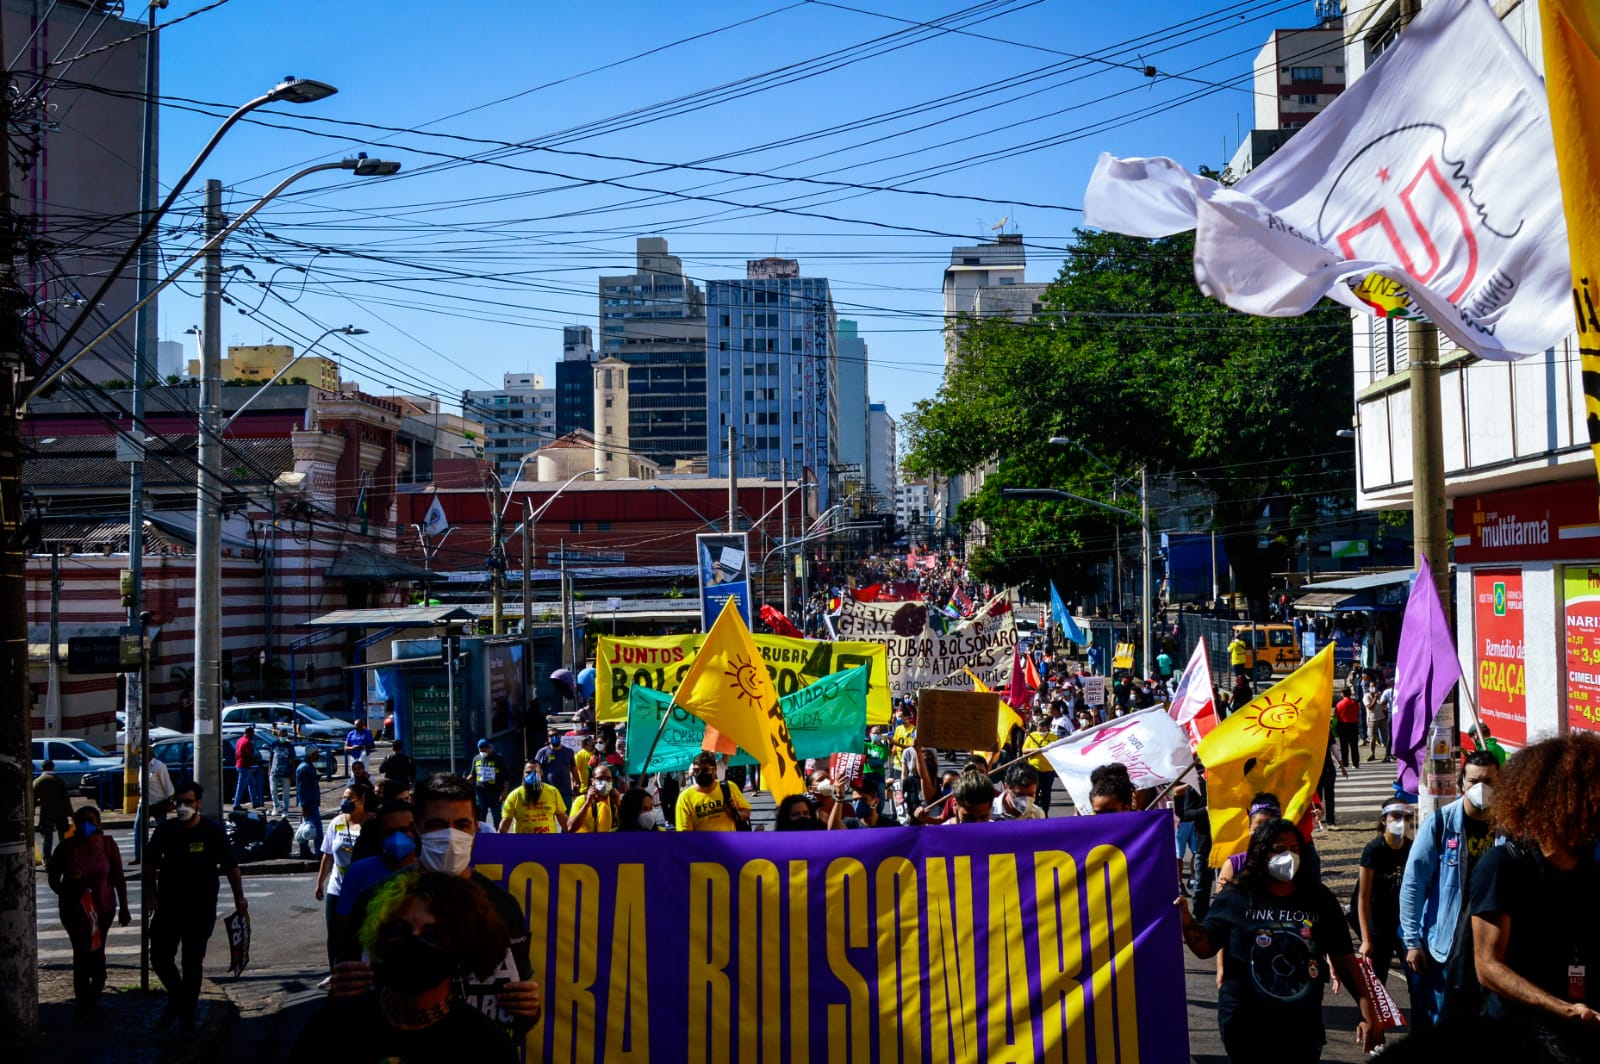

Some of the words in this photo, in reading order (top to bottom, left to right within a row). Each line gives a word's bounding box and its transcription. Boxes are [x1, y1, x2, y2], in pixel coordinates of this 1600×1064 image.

[1482, 515, 1549, 547] multifarma
[841, 598, 894, 623] GREVE
[1567, 615, 1600, 627] NARI
[840, 616, 896, 636] GERAL
[610, 644, 684, 664] JUNTOS
[939, 629, 1018, 655] BOLSONARO
[1486, 639, 1515, 658] Remédio
[918, 657, 931, 668] os
[932, 649, 996, 675] ATAQUES
[906, 680, 931, 690] nova
[1480, 660, 1526, 703] GRAÇA
[688, 844, 1140, 1064] BOLSONARO
